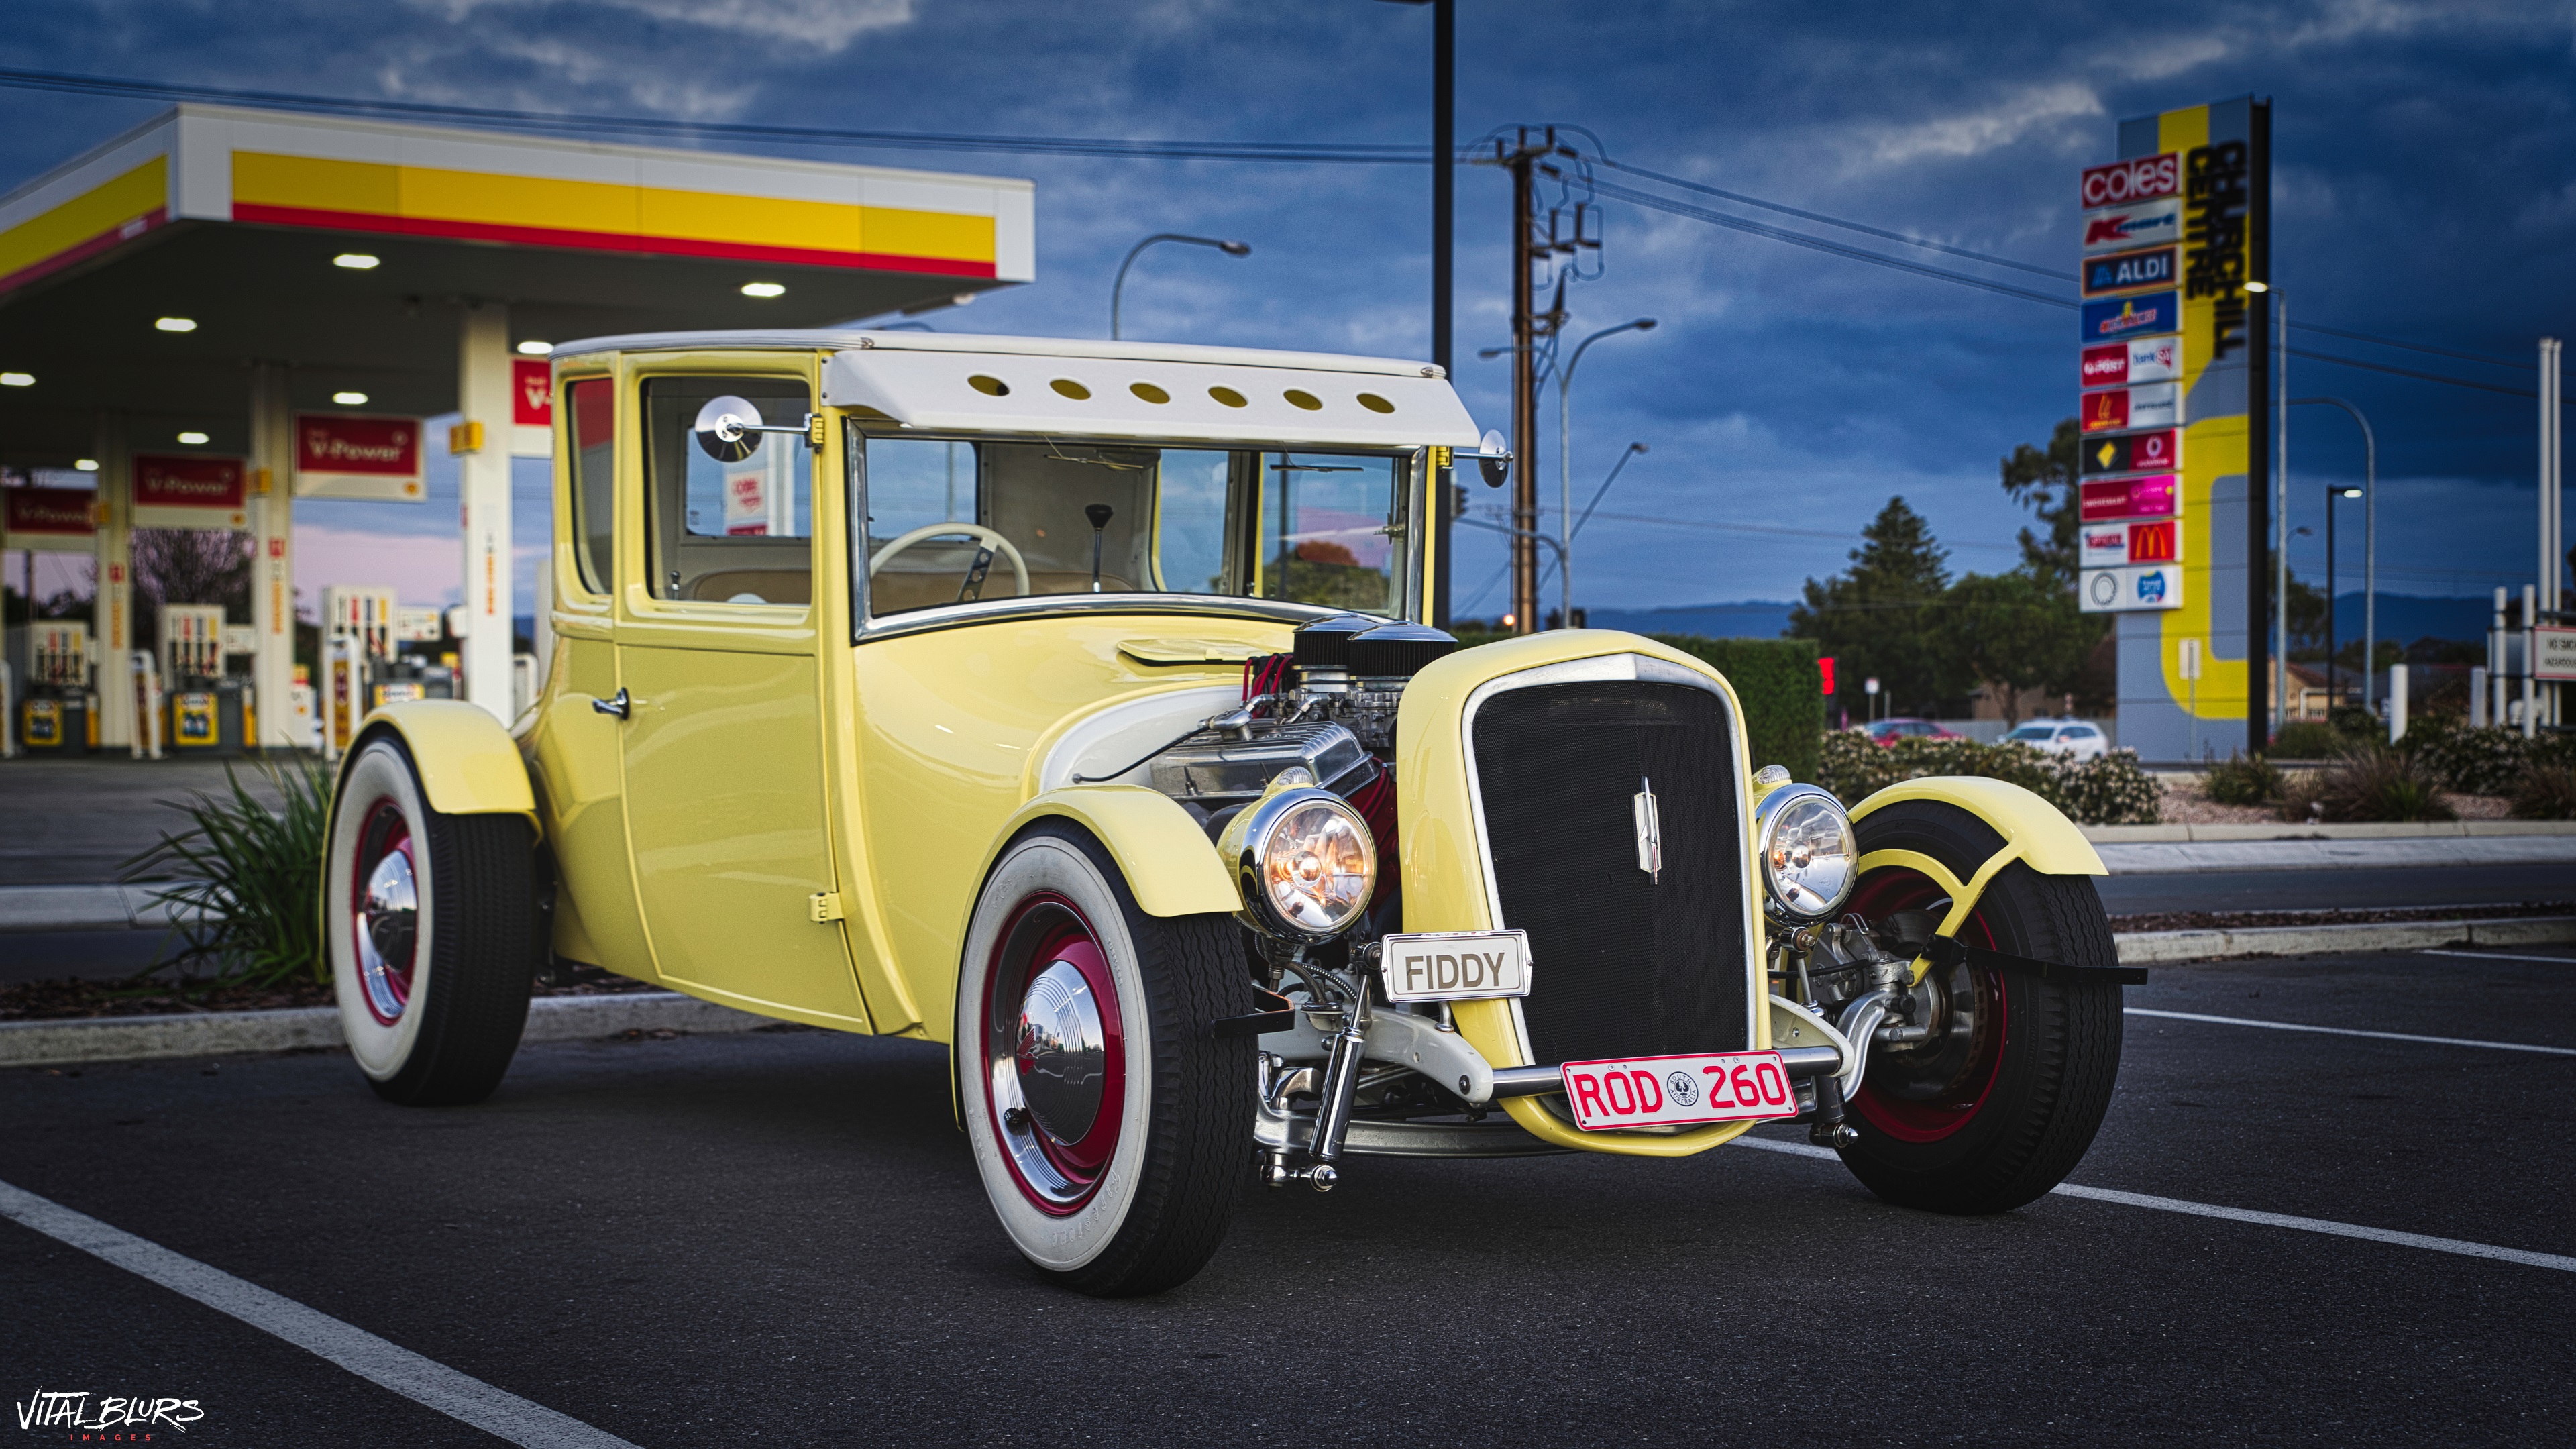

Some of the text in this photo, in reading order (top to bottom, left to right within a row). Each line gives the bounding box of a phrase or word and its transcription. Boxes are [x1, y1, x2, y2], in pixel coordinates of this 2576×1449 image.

[2084, 158, 2176, 204] coles
[2186, 146, 2214, 300] CENTRE
[2115, 254, 2168, 286] ALDI
[2214, 140, 2247, 358] CHURCHILL
[1405, 953, 1505, 991] FIDDY
[1573, 1063, 1786, 1118] ROD 260
[1670, 1074, 1692, 1085] SOUTH
[1670, 1089, 1696, 1104] AUSTRALIA
